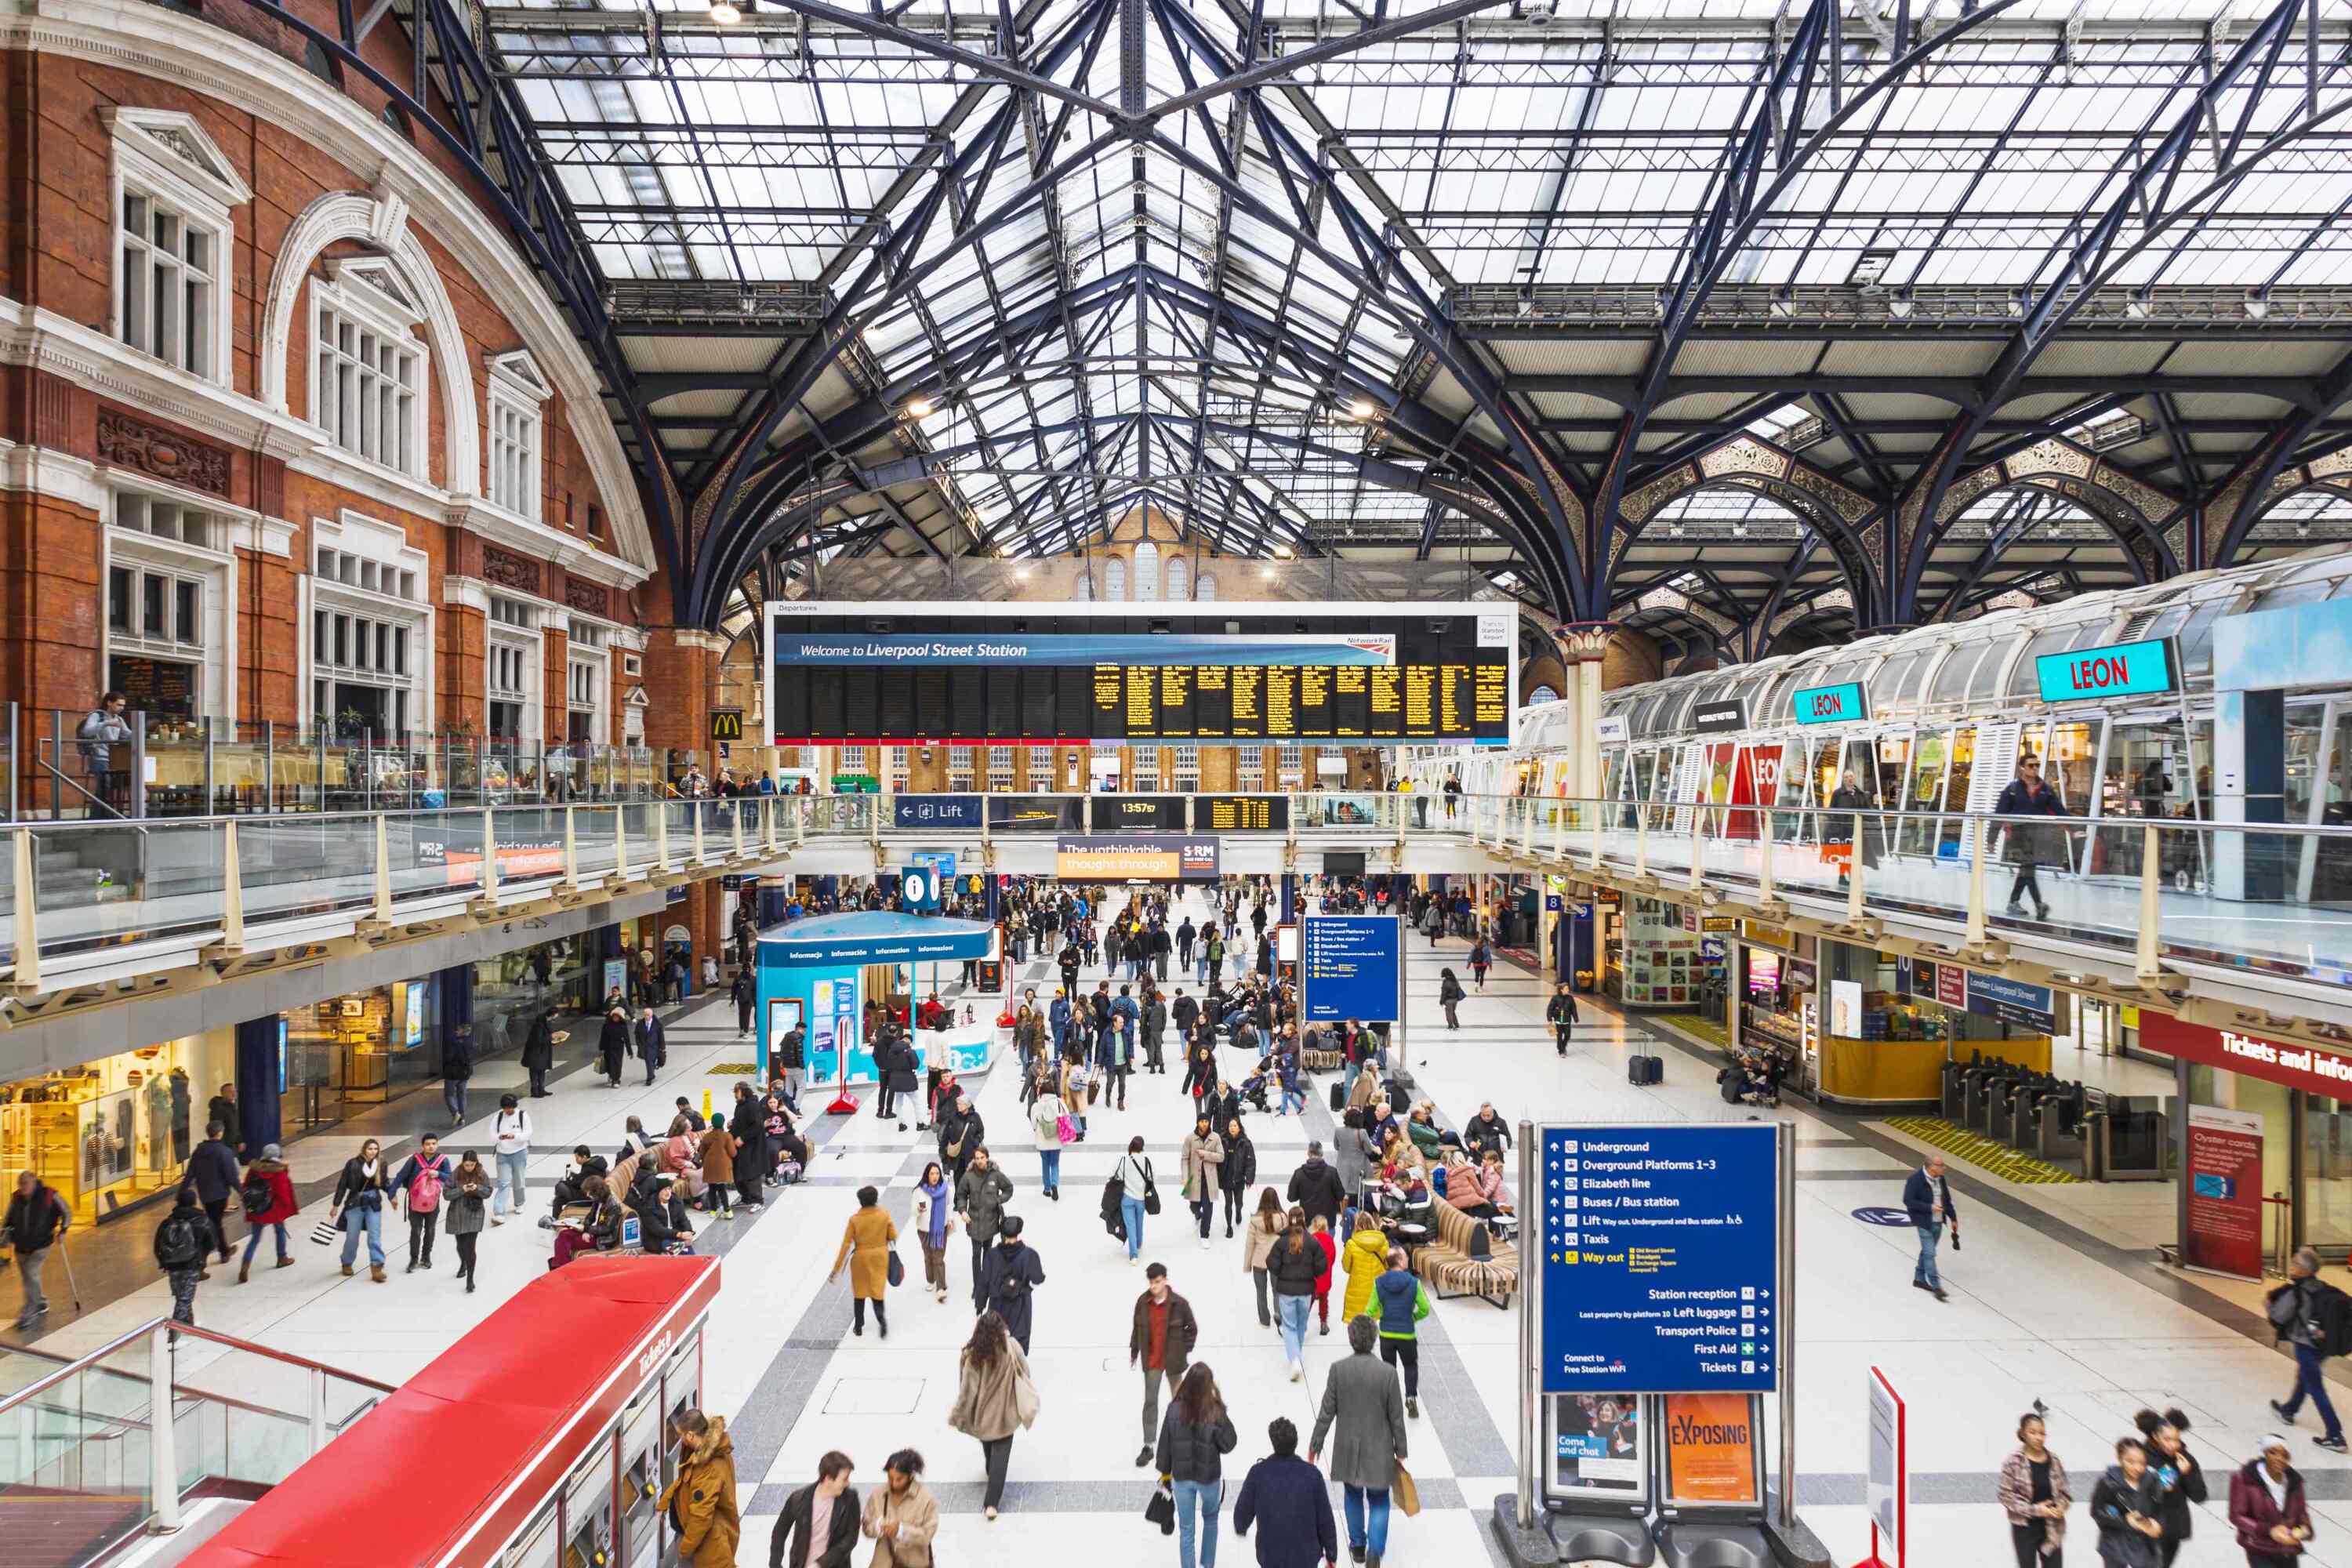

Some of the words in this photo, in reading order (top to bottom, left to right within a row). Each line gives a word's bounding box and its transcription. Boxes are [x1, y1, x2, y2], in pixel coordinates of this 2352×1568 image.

[801, 645, 850, 656] Welcome
[853, 646, 864, 656] to
[866, 644, 929, 659] Liverpool
[932, 644, 974, 656] Street
[977, 644, 1027, 656] Station
[2071, 655, 2130, 690] LEON
[1811, 692, 1842, 716] LEON
[940, 804, 963, 817] Lift
[1066, 858, 1116, 871] thought
[1550, 898, 1557, 907] 8
[1970, 978, 1990, 989] London
[1991, 982, 2016, 996] Liverpool
[2017, 989, 2036, 1001] Street
[2220, 1031, 2277, 1063] Tickets
[2279, 1050, 2311, 1071] and
[2194, 1133, 2227, 1143] Oyster
[1583, 1142, 1650, 1152] Underground
[1583, 1160, 1643, 1171] Overground
[1646, 1160, 1693, 1170] Platforms
[1583, 1179, 1630, 1189] Elizabeth
[1632, 1179, 1650, 1189] line
[1583, 1197, 1613, 1207] Buses
[1623, 1197, 1642, 1207] Bus
[1644, 1198, 1679, 1207] station
[1583, 1216, 1601, 1225] Lift
[1583, 1234, 1610, 1244] Taxis
[1583, 1253, 1604, 1264] Way
[1607, 1254, 1624, 1262] out
[1649, 1290, 1686, 1299] Station
[1687, 1290, 1737, 1301] reception
[1673, 1308, 1695, 1317] Left
[1697, 1308, 1737, 1319] luggage
[1655, 1327, 1704, 1338] Transport
[1706, 1327, 1737, 1335] Police
[1694, 1345, 1717, 1353] First
[1719, 1345, 1737, 1353] Aid
[640, 1338, 666, 1377] Tickets
[1700, 1363, 1737, 1372] Tickets
[1559, 1436, 1585, 1446] Come
